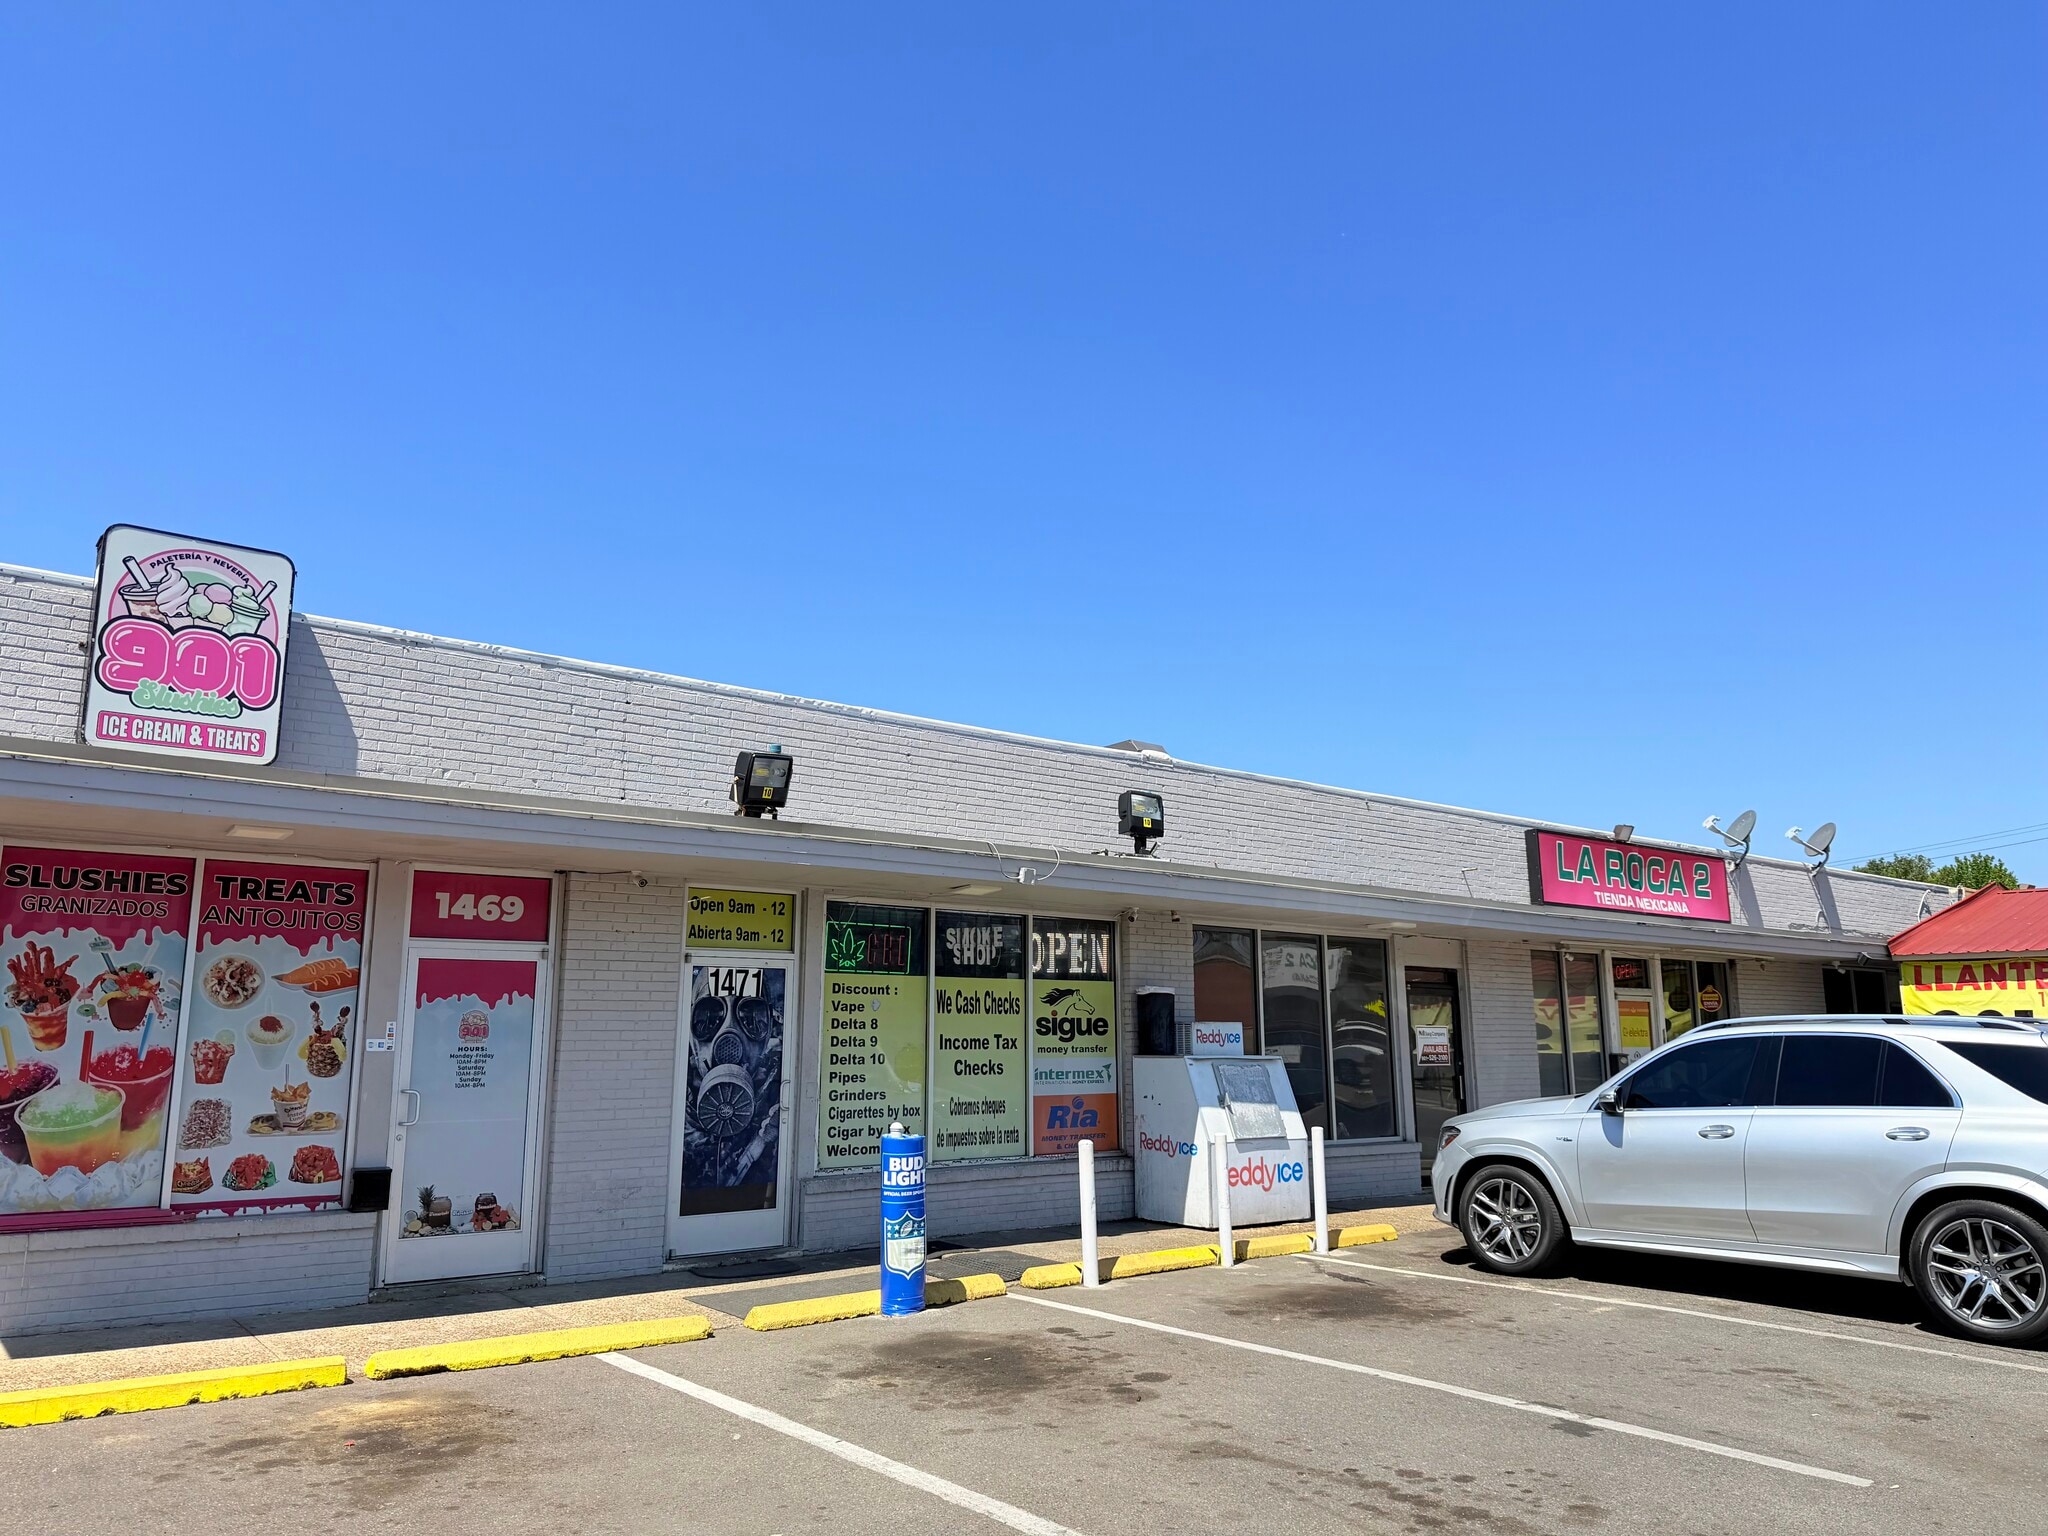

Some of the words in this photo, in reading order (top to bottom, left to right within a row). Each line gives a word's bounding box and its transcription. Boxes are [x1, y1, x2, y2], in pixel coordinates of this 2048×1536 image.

[150, 552, 203, 569] PALETERÍA
[212, 558, 250, 584] NEVERÍA
[98, 619, 279, 709] 901
[132, 678, 242, 718] Slushies
[102, 715, 128, 735] ICE
[131, 718, 186, 744] CREAM
[189, 724, 203, 746] &
[207, 726, 261, 752] TREATS
[1555, 840, 1600, 885] LA
[1605, 849, 1689, 897] ROCA
[1693, 863, 1712, 900] 2
[4, 864, 188, 896] SLUSHIES
[214, 875, 356, 906] TREATS
[1593, 890, 1635, 909] TIENDA
[19, 895, 169, 918] GRANIZADOS
[435, 892, 525, 922] 1469
[690, 895, 724, 915] Open
[728, 898, 755, 914] 9am
[771, 901, 785, 916] 12
[200, 906, 362, 932] ANTOJITOS
[688, 924, 732, 941] Abierta
[735, 926, 760, 942] 9am
[770, 929, 784, 943] 12
[946, 927, 1004, 950] SMOKE
[1032, 932, 1110, 974] OPEN
[709, 968, 762, 997] 1471
[831, 983, 891, 996] Discount
[831, 1001, 865, 1014] Vape
[936, 990, 954, 1014] We
[955, 990, 982, 1015] Cash
[984, 990, 1021, 1016] Checks
[459, 1024, 490, 1039] 901
[831, 1018, 866, 1030] Delta
[870, 1018, 879, 1030] 8
[1035, 1010, 1109, 1042] sigue
[1628, 1027, 1649, 1038] elektra
[830, 1035, 866, 1048] Delta
[869, 1035, 878, 1047] 9
[939, 1033, 990, 1050] Income
[993, 1033, 1019, 1050] Tax
[1037, 1046, 1069, 1055] money
[1071, 1045, 1108, 1053] transfer
[829, 1053, 866, 1066] Delta
[869, 1053, 885, 1066] 10
[953, 1059, 1004, 1076] Checks
[829, 1071, 866, 1085] Pipes
[1034, 1067, 1104, 1081] intermex
[828, 1089, 887, 1101] Grinders
[828, 1105, 885, 1121] Cigarettes
[887, 1104, 900, 1119] by
[902, 1104, 921, 1117] box
[949, 1097, 980, 1117] Cobramos
[981, 1098, 1006, 1118] cheques
[1047, 1096, 1099, 1129] Ria
[827, 1125, 866, 1140] Cigar
[868, 1124, 883, 1139] by
[936, 1129, 945, 1148] de
[945, 1129, 977, 1149] impuestos
[978, 1129, 995, 1147] sobre
[996, 1129, 1002, 1145] la
[1003, 1129, 1020, 1145] renta
[1041, 1134, 1069, 1142] MONEY
[1070, 1132, 1107, 1141] TRANSFER
[827, 1144, 881, 1157] Welcom
[889, 1156, 924, 1171] BUD
[883, 1168, 925, 1186] LIGHT
